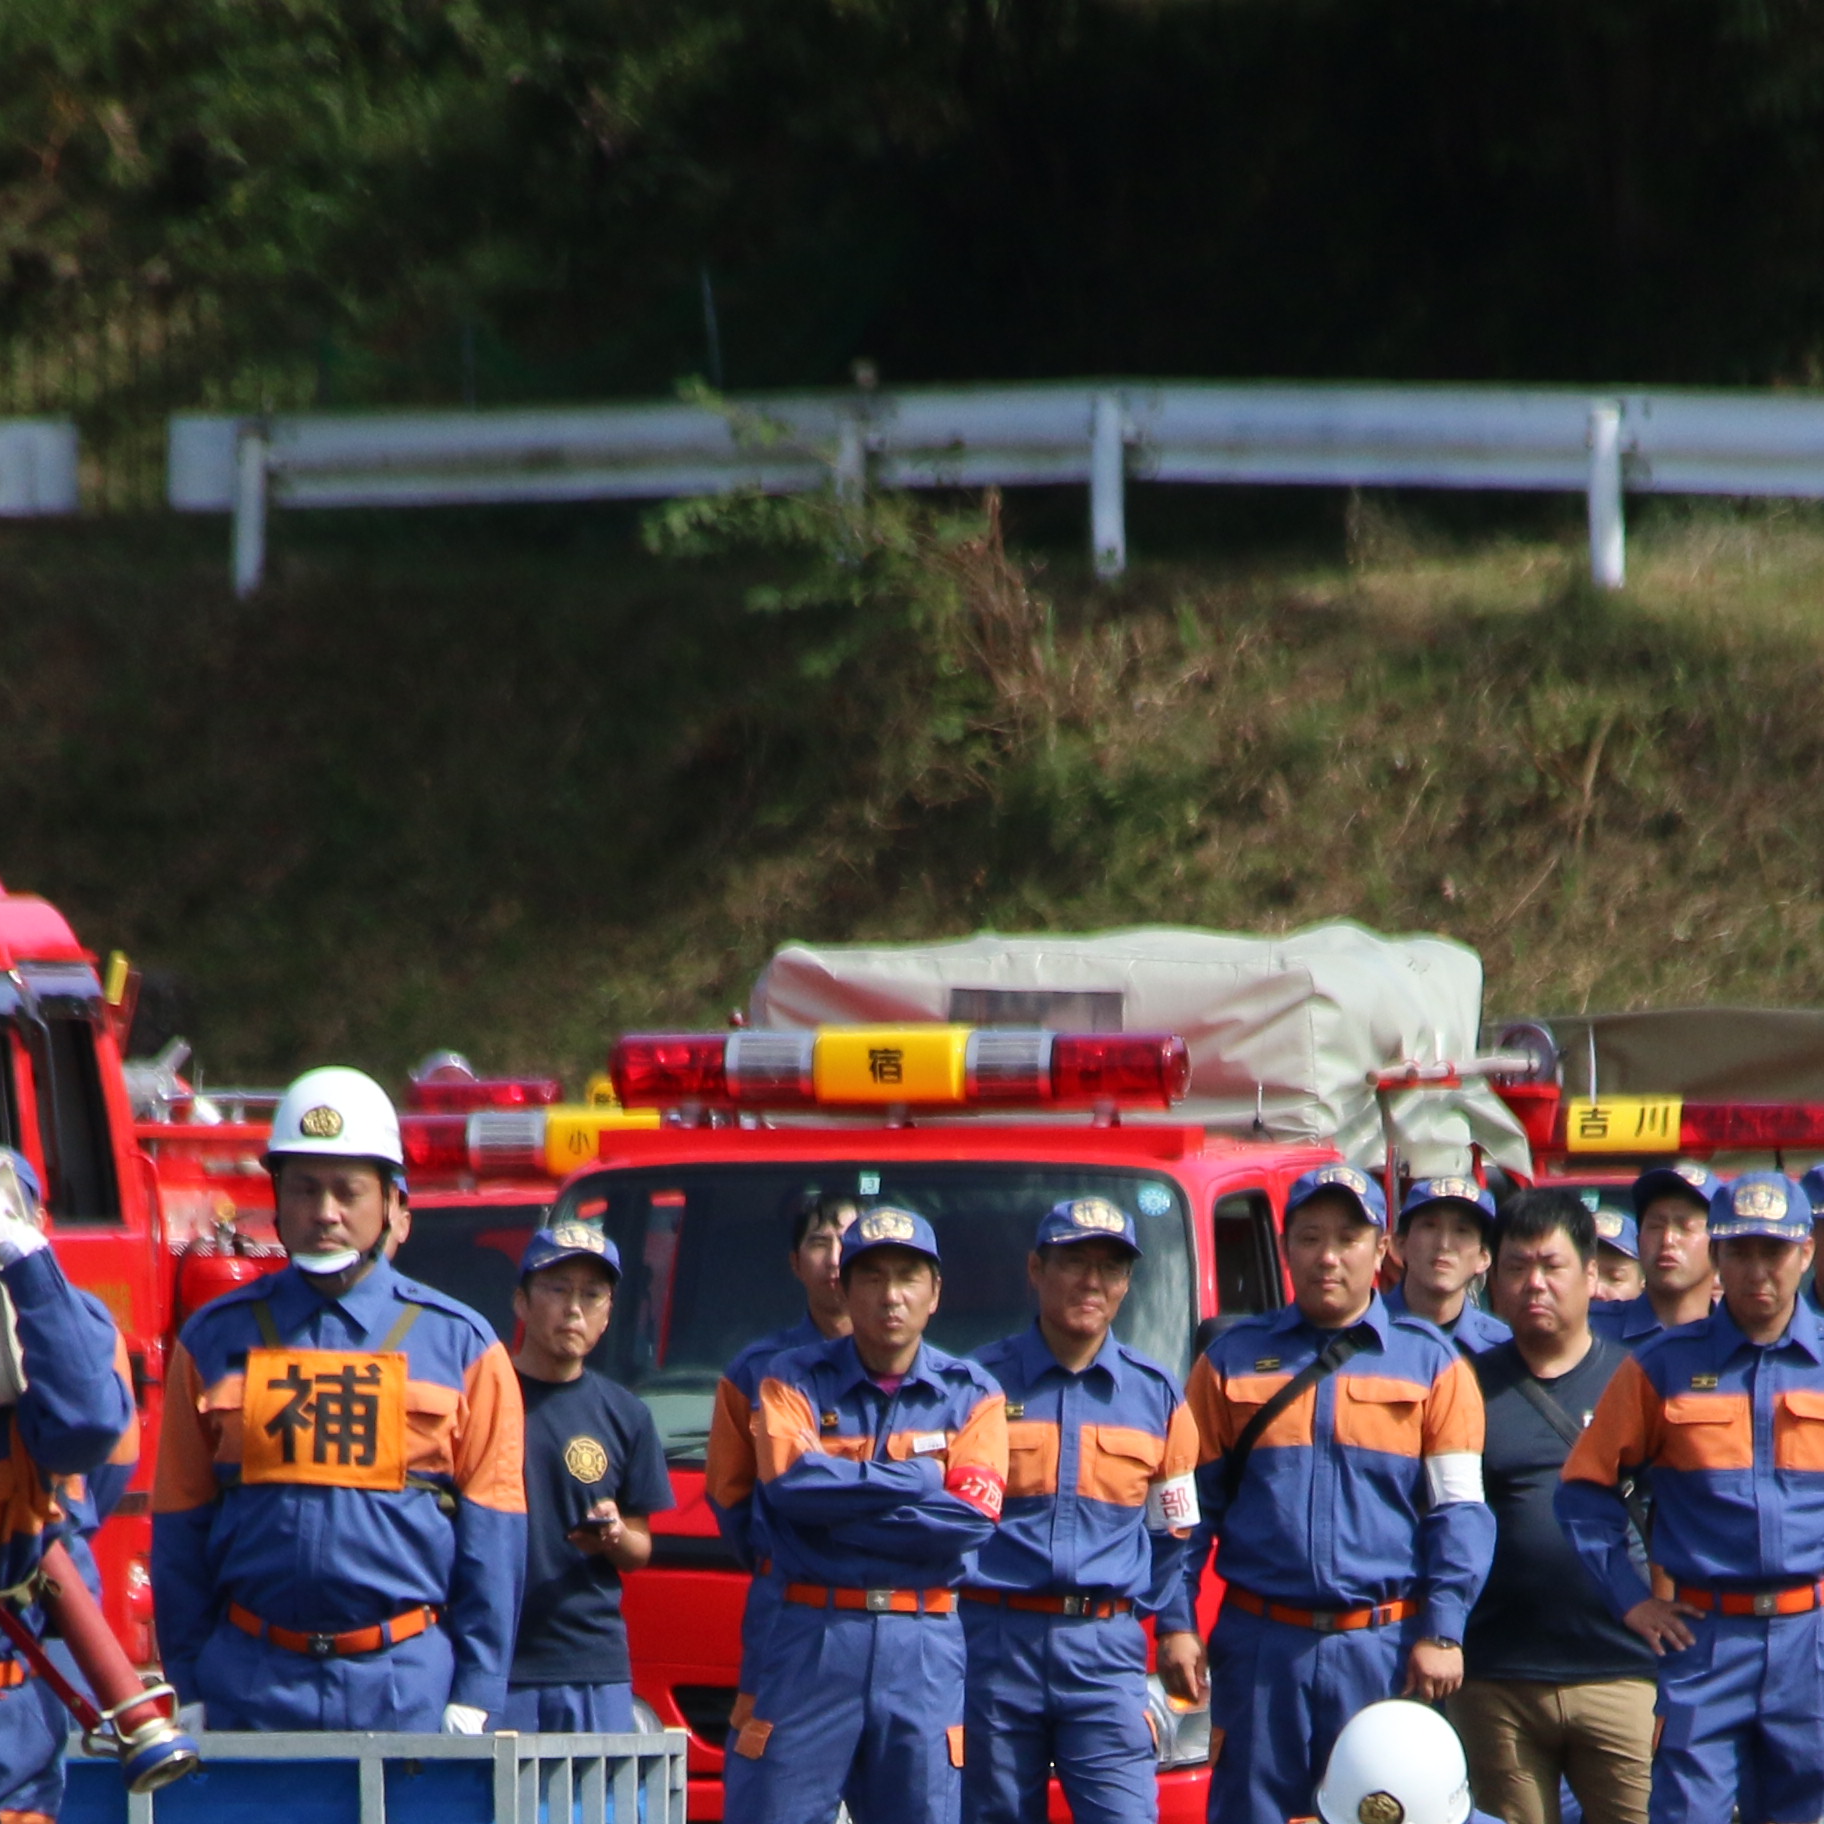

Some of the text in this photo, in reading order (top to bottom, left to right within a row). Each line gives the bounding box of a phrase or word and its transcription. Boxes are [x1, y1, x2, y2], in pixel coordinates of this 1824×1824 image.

[869, 1048, 903, 1084] 宿
[1579, 1106, 1670, 1138] 吉川
[568, 1127, 591, 1156] 小
[265, 1363, 382, 1466] 補
[1159, 1486, 1190, 1520] 部
